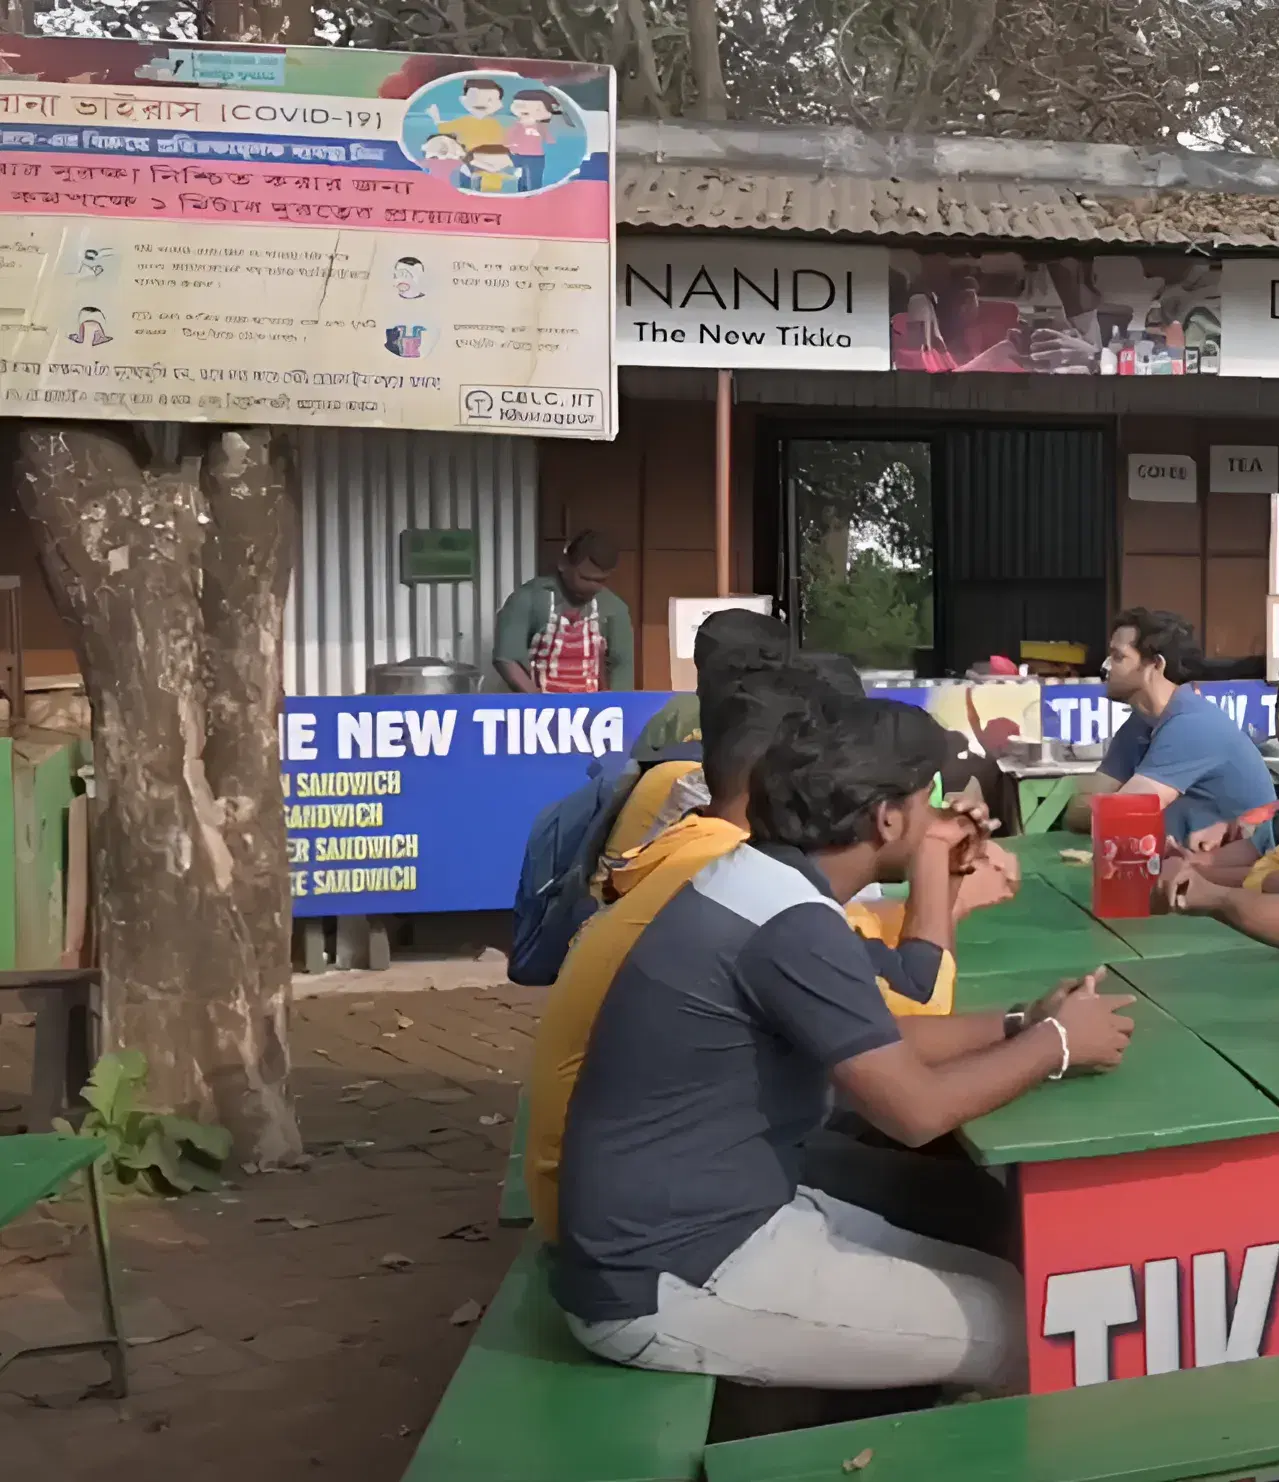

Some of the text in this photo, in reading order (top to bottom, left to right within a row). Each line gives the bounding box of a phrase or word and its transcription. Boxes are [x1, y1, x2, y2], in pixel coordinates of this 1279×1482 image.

[625, 263, 853, 314] NANDI
[633, 320, 686, 343] The
[337, 709, 458, 760] NEW
[472, 706, 624, 759] TIKKA
[297, 770, 401, 798] SANDWICH
[315, 833, 419, 862] SANDWICH
[313, 865, 417, 896] SANDWICH
